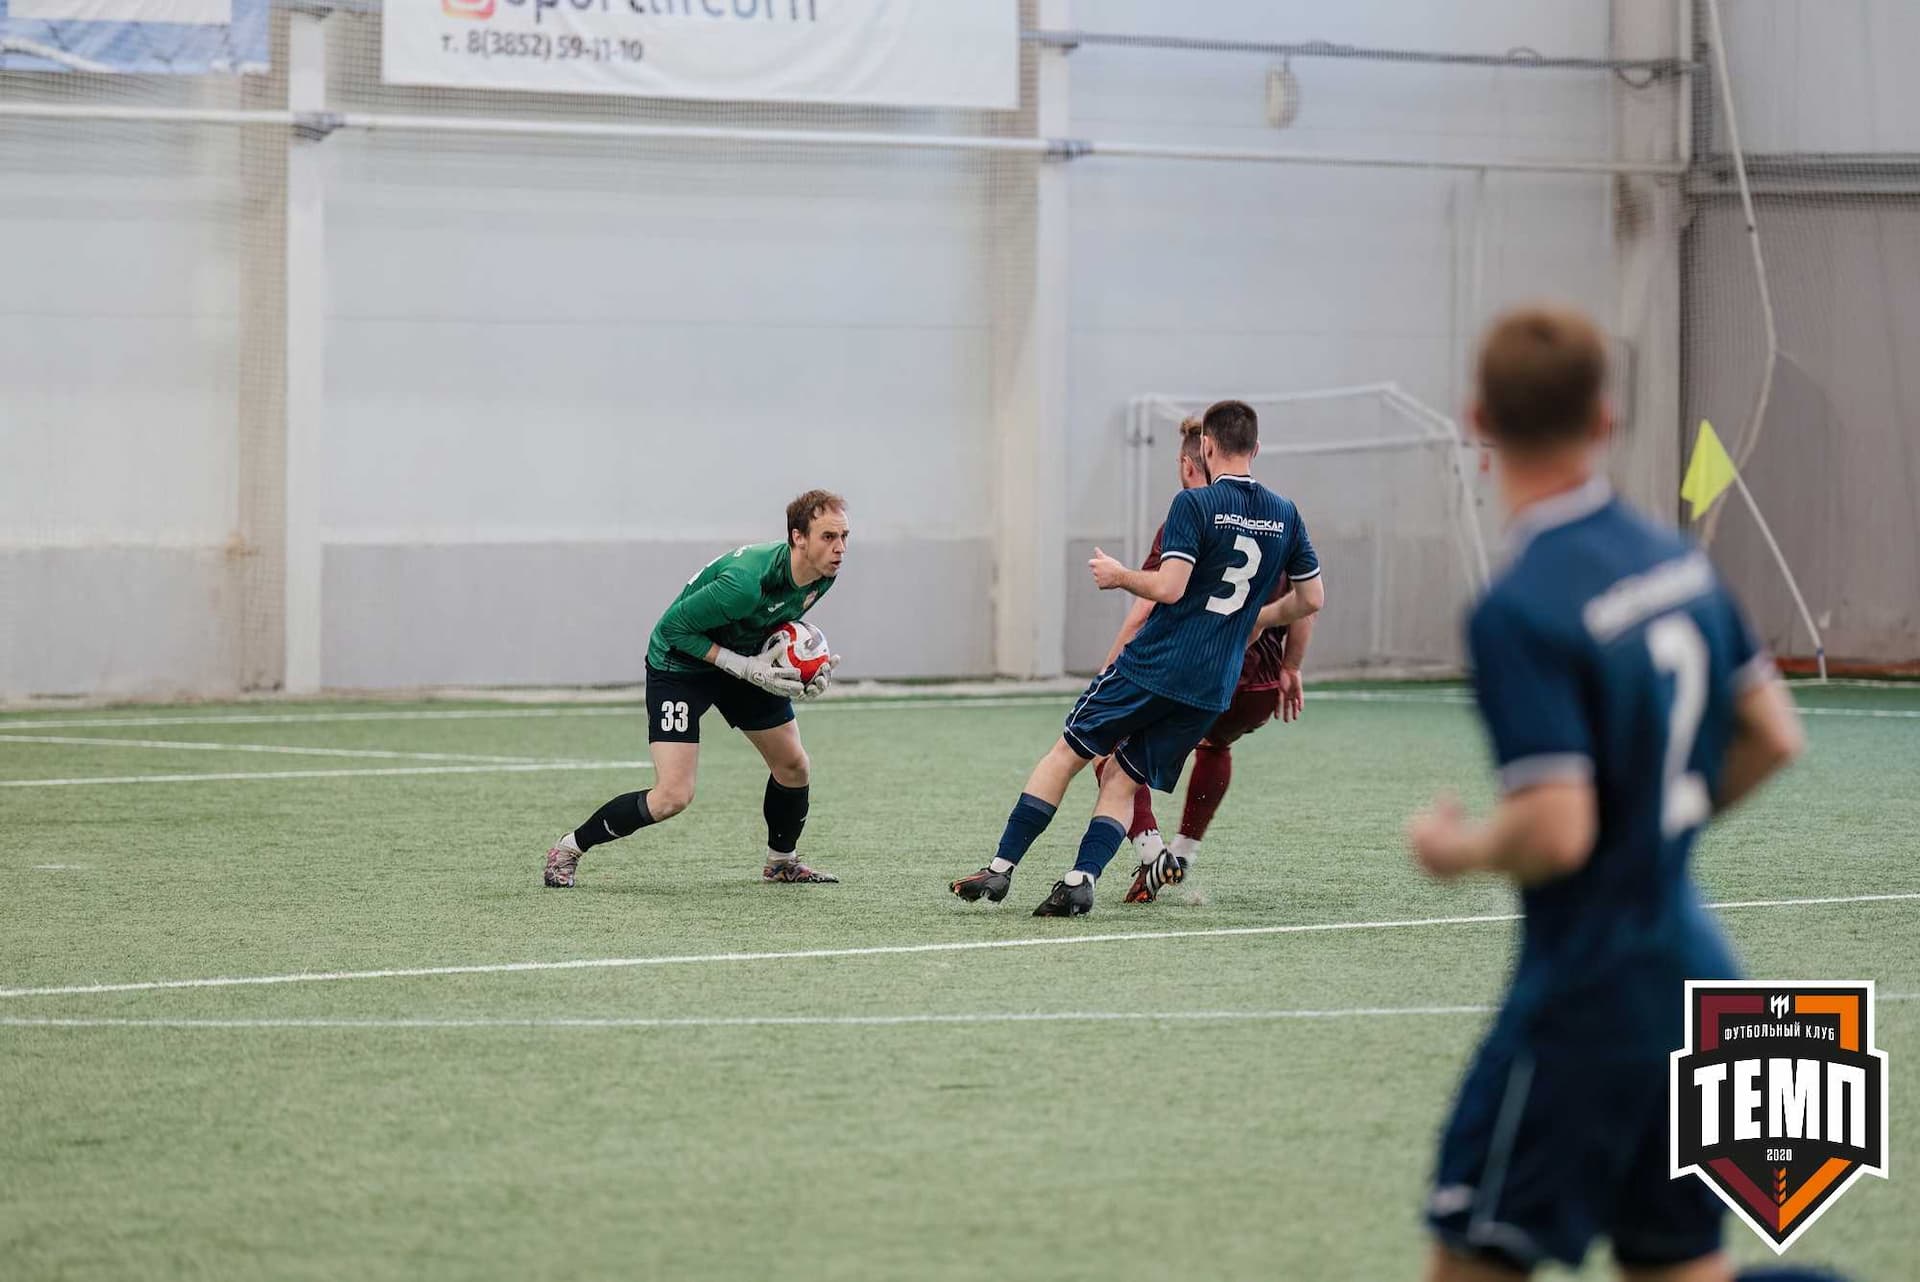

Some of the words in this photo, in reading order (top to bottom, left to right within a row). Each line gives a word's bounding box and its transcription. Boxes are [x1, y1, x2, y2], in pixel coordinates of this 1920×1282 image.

[467, 29, 552, 62] 8(3852)
[557, 34, 645, 62] 59-11-10
[1205, 534, 1262, 616] 3
[660, 700, 689, 732] 33
